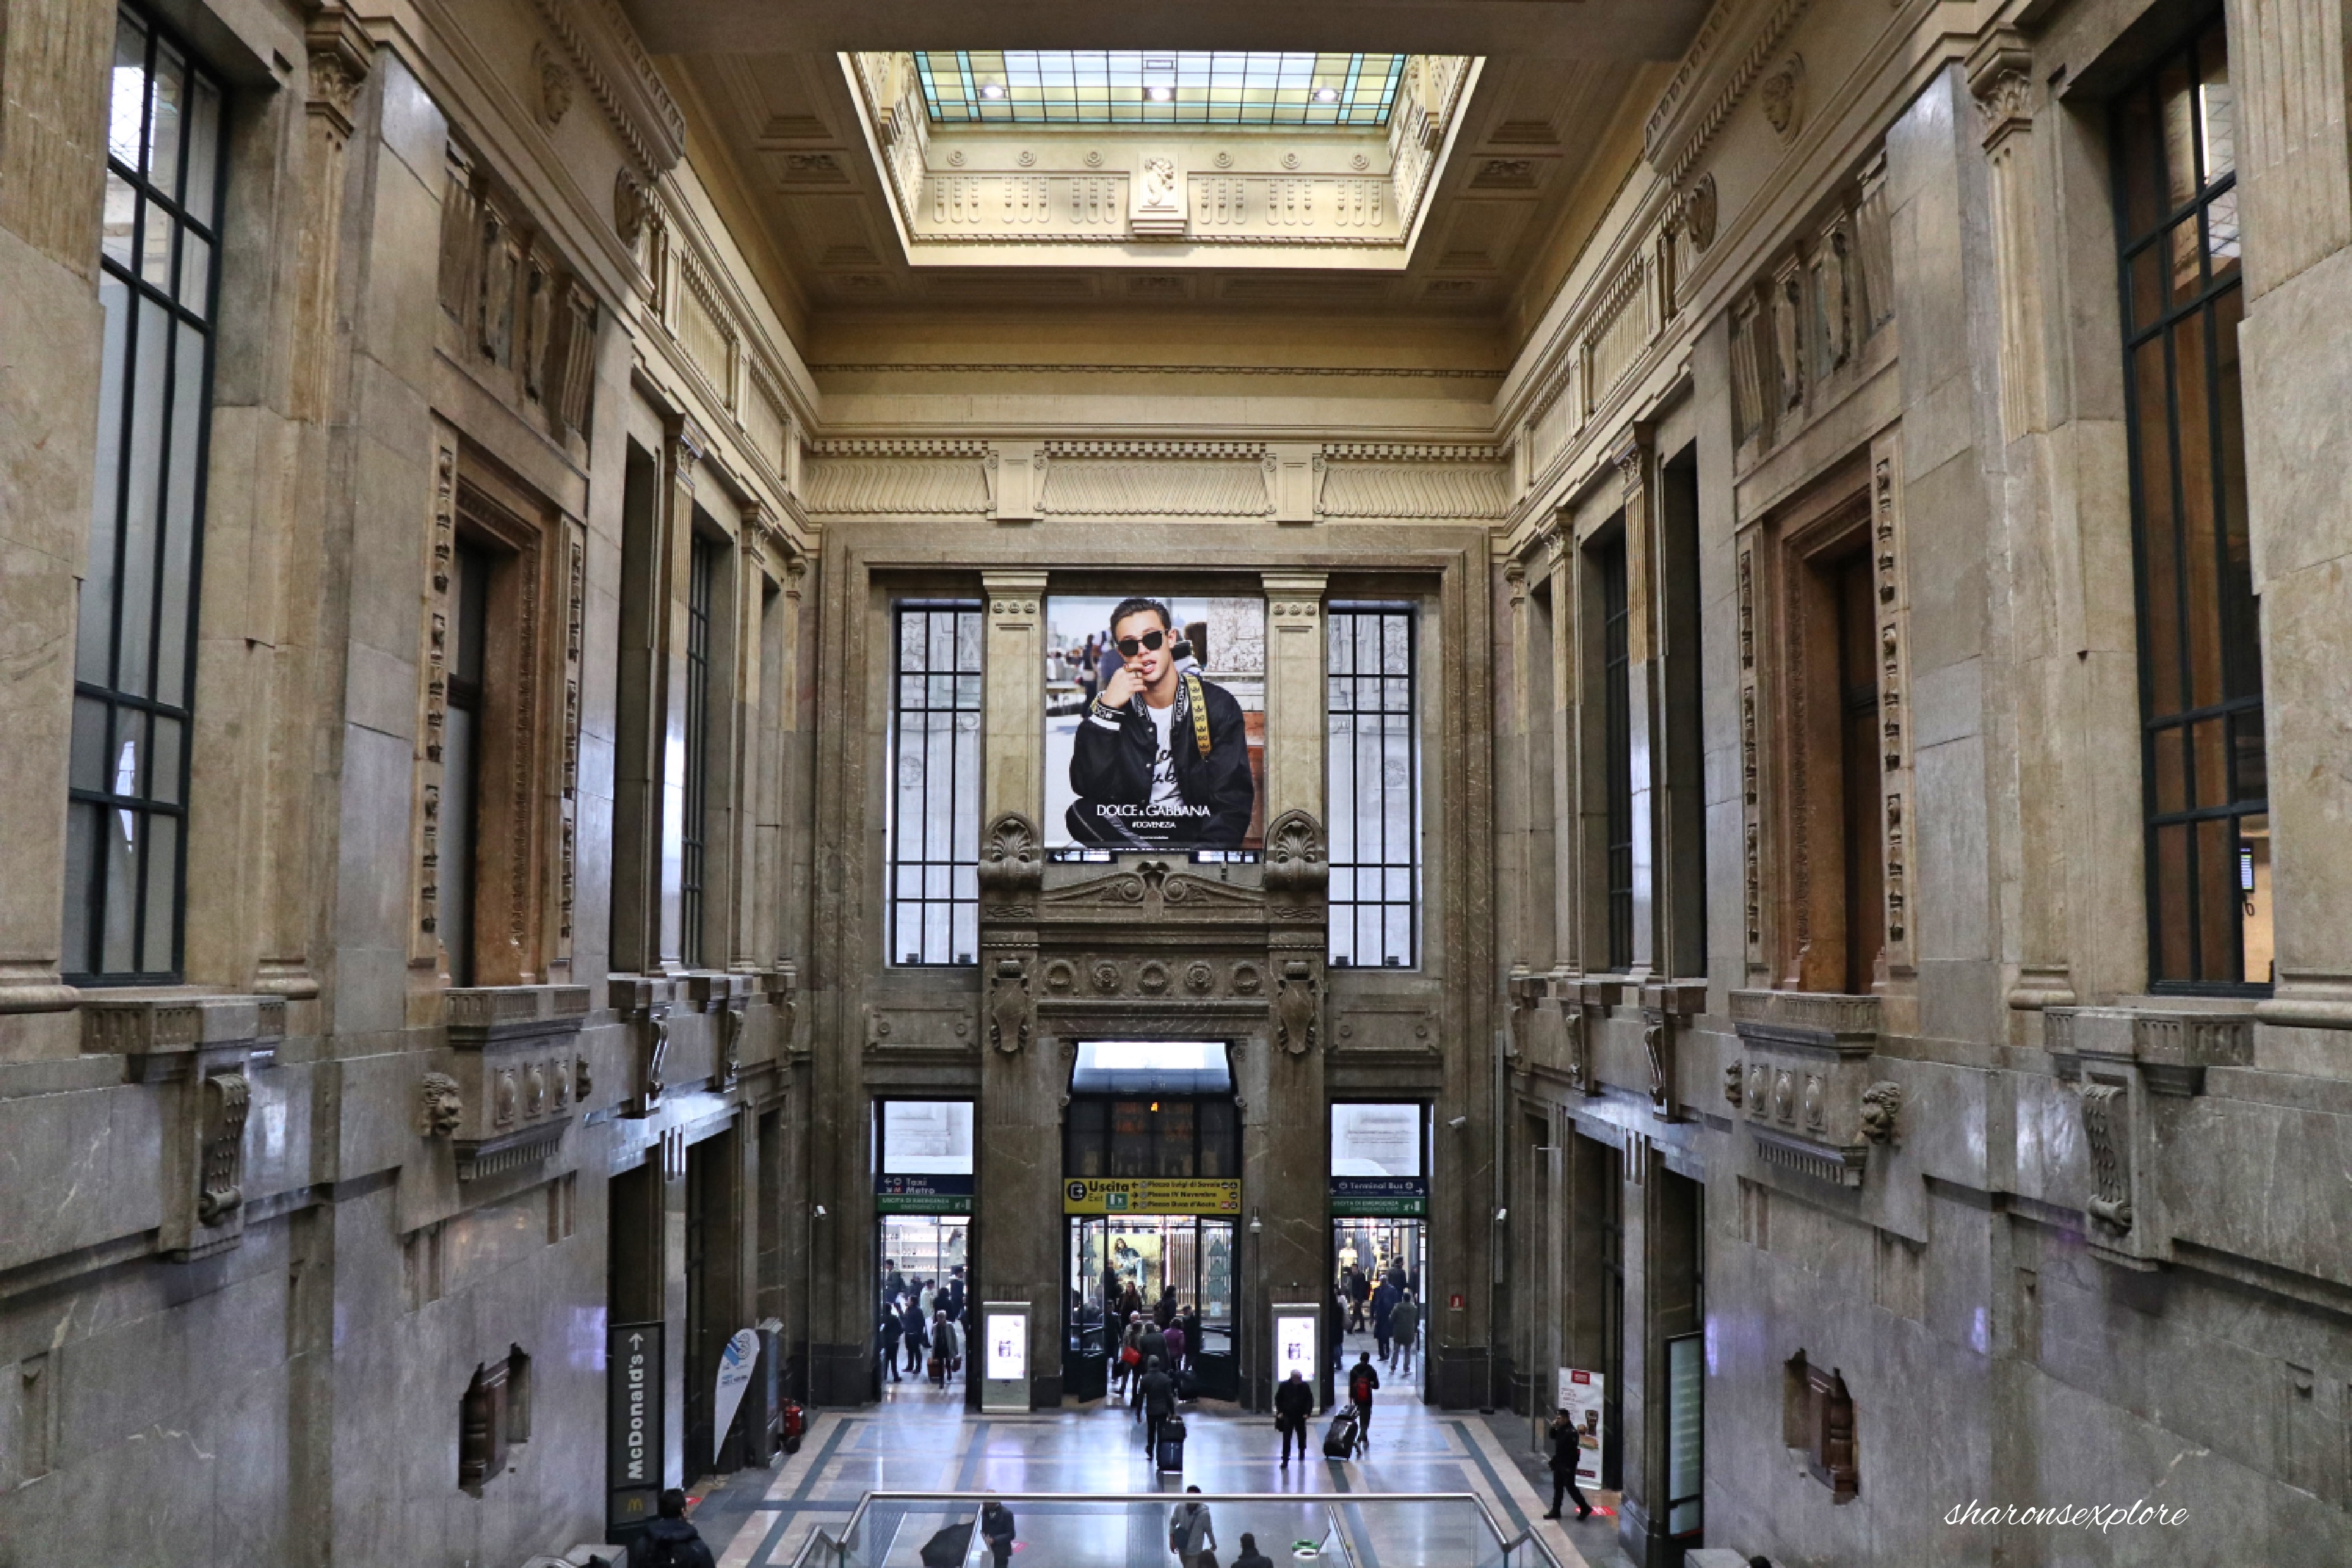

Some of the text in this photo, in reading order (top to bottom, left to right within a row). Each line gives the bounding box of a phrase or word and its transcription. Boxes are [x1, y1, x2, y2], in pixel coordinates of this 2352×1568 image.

[1096, 804, 1138, 816] DOLCE
[1146, 805, 1211, 817] GABBANA
[906, 1177, 927, 1186] Taxi
[1089, 1181, 1129, 1192] Uscita
[906, 1186, 936, 1194] Metro
[1088, 1193, 1103, 1202] Exit
[628, 1354, 644, 1480] McDonald's
